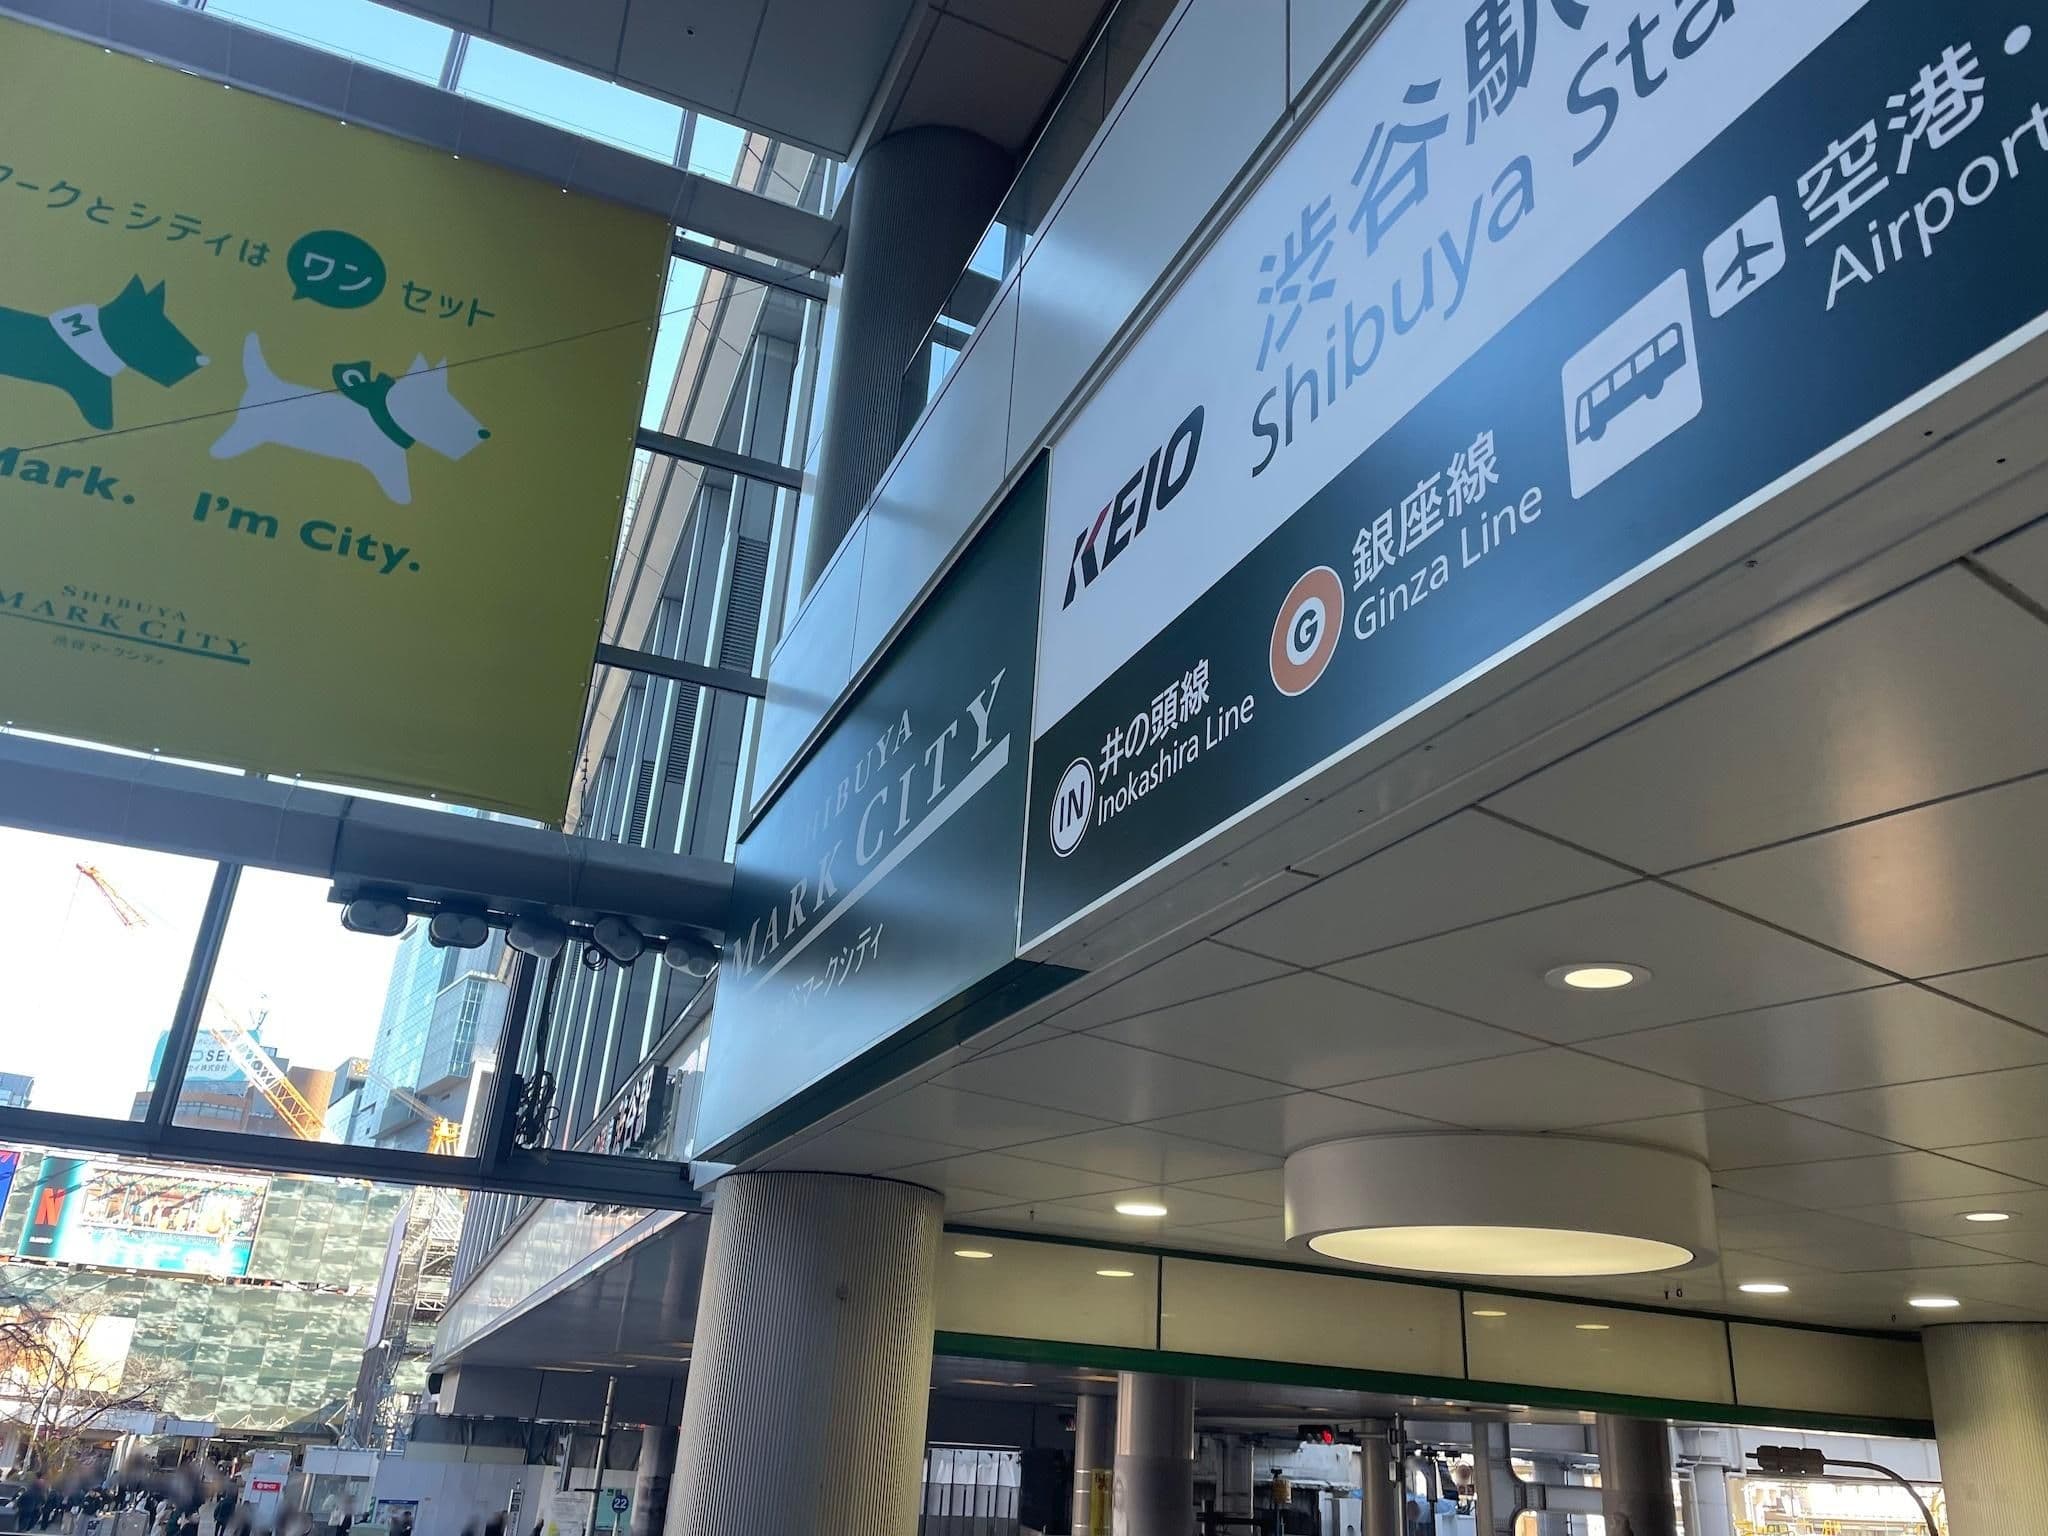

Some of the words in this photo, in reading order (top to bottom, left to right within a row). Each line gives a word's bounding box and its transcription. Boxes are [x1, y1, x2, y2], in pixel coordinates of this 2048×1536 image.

[61, 312, 93, 337] M
[303, 252, 372, 291] ワン
[402, 281, 495, 327] セット
[1252, 154, 1535, 478] Shibuya
[300, 519, 420, 574] City.
[1062, 405, 1205, 611] KEIO
[1352, 429, 1499, 592] 銀座線
[1354, 554, 1449, 640] Ginza
[1461, 486, 1542, 569] Line
[138, 619, 248, 656] CITY
[1294, 608, 1318, 653] G
[802, 709, 913, 851] HIBUYA
[1098, 734, 1199, 826] Inokashira
[1206, 694, 1255, 750] Line
[1099, 658, 1210, 785] 井の頭線
[732, 838, 844, 984] MARK
[856, 667, 1006, 867] CITY
[1059, 780, 1086, 833] IN
[613, 1498, 627, 1509] 22
